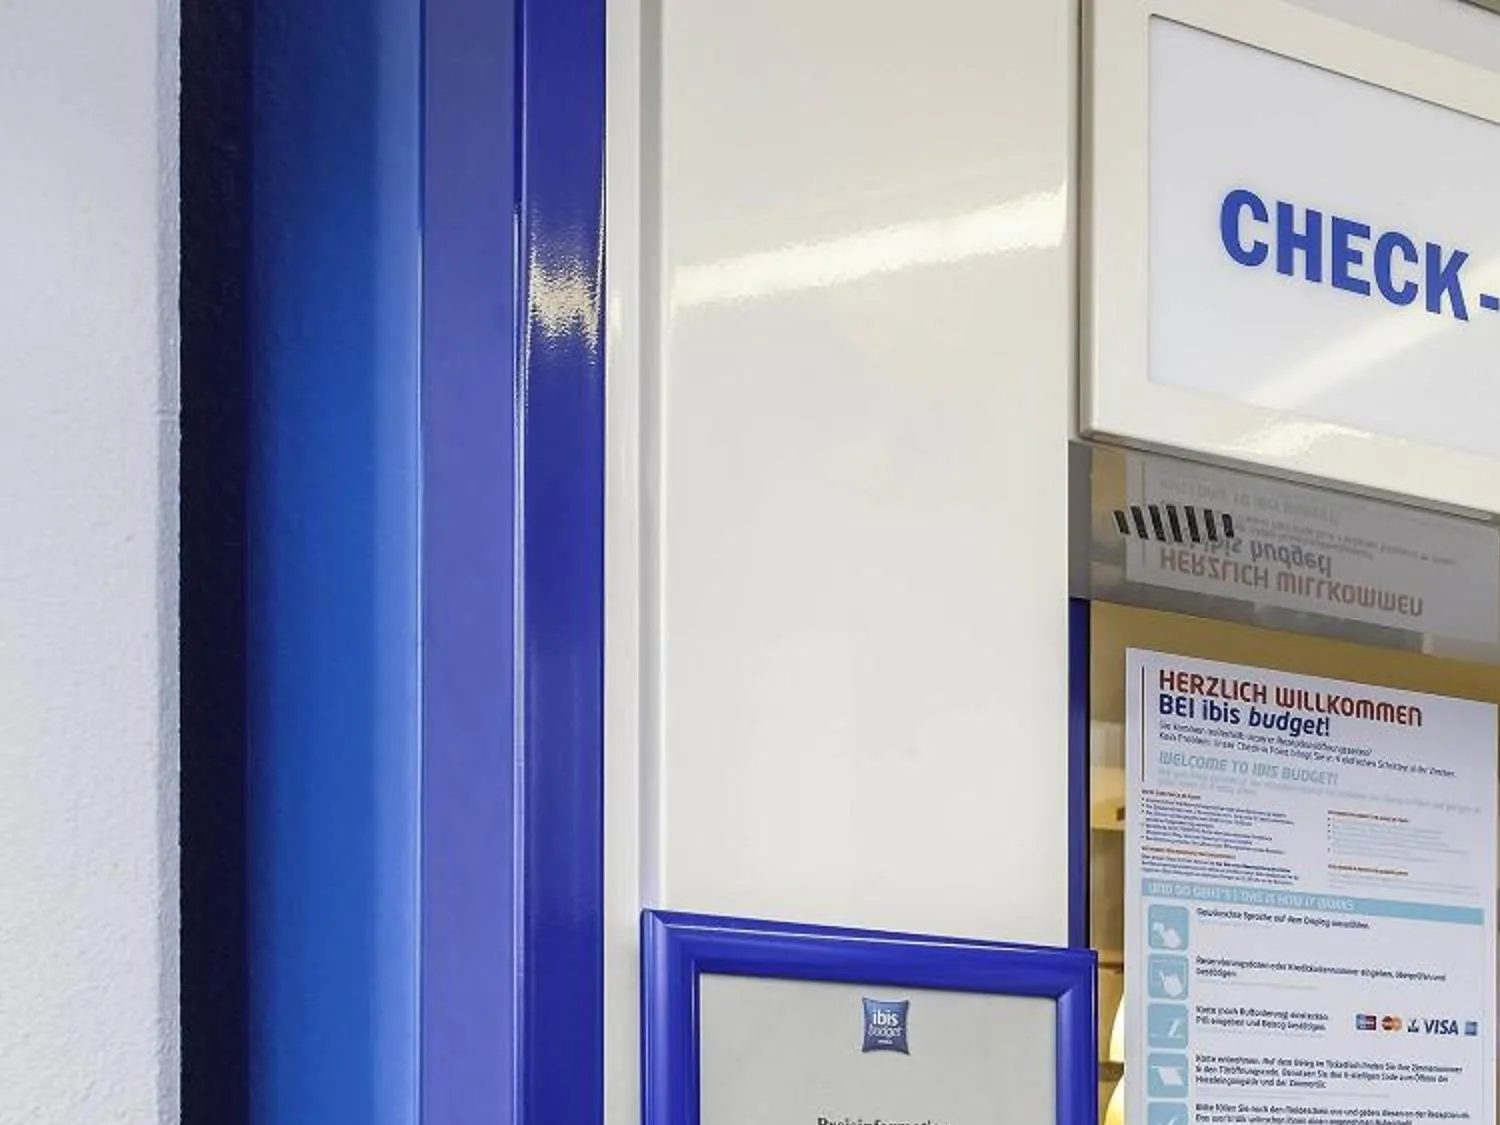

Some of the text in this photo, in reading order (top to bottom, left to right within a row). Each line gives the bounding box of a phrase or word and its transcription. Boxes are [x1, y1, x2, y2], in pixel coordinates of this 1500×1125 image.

[1159, 669, 1423, 727] HERZLICH WILLKOMMEN
[1159, 693, 1330, 738] BEI ibis budget!
[1159, 750, 1229, 771] WELCOME
[1231, 760, 1249, 774] TO
[1252, 762, 1280, 778] IBIS
[872, 1009, 899, 1027] ibis
[1423, 1018, 1460, 1036] VISA
